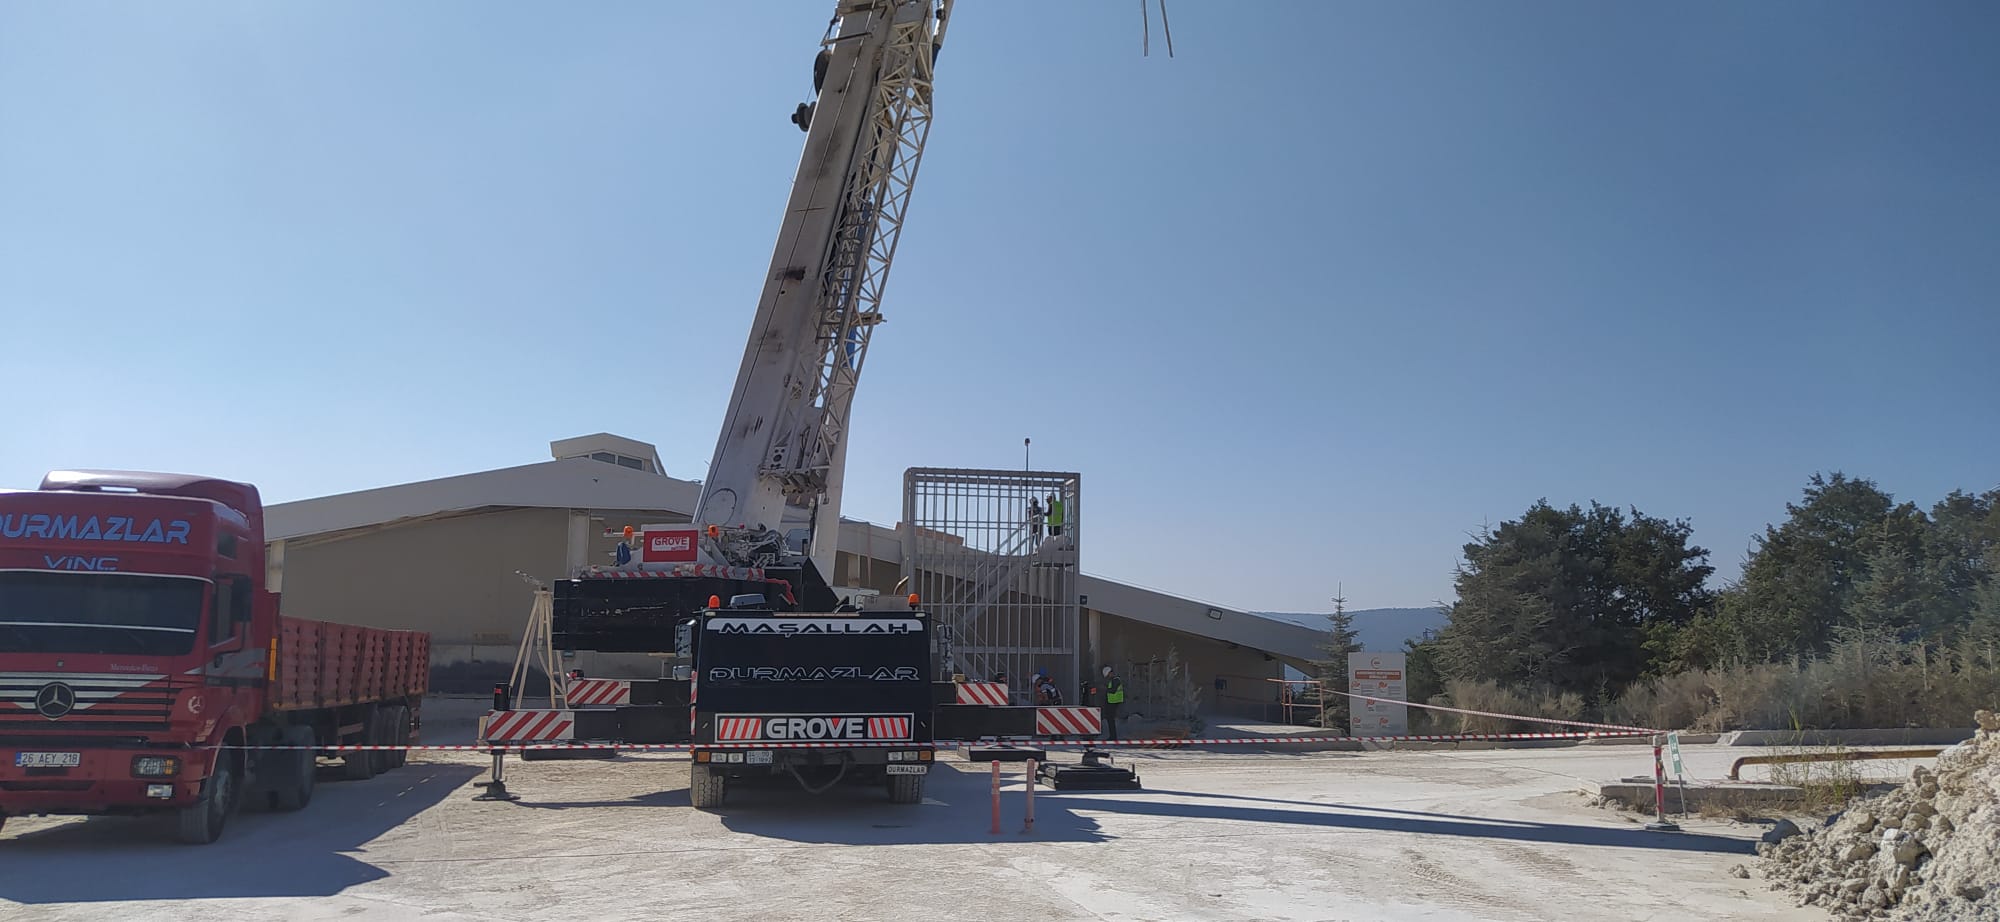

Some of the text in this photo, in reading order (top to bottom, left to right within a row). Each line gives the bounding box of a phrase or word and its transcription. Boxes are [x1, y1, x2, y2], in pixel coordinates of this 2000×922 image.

[0, 514, 191, 544] URMAZLAR
[654, 537, 688, 546] GROVE
[719, 622, 909, 638] MAŞALLAH
[709, 666, 920, 681] DURMAZLAR
[766, 717, 864, 739] GROVE
[22, 754, 78, 763] 26 AEY 218
